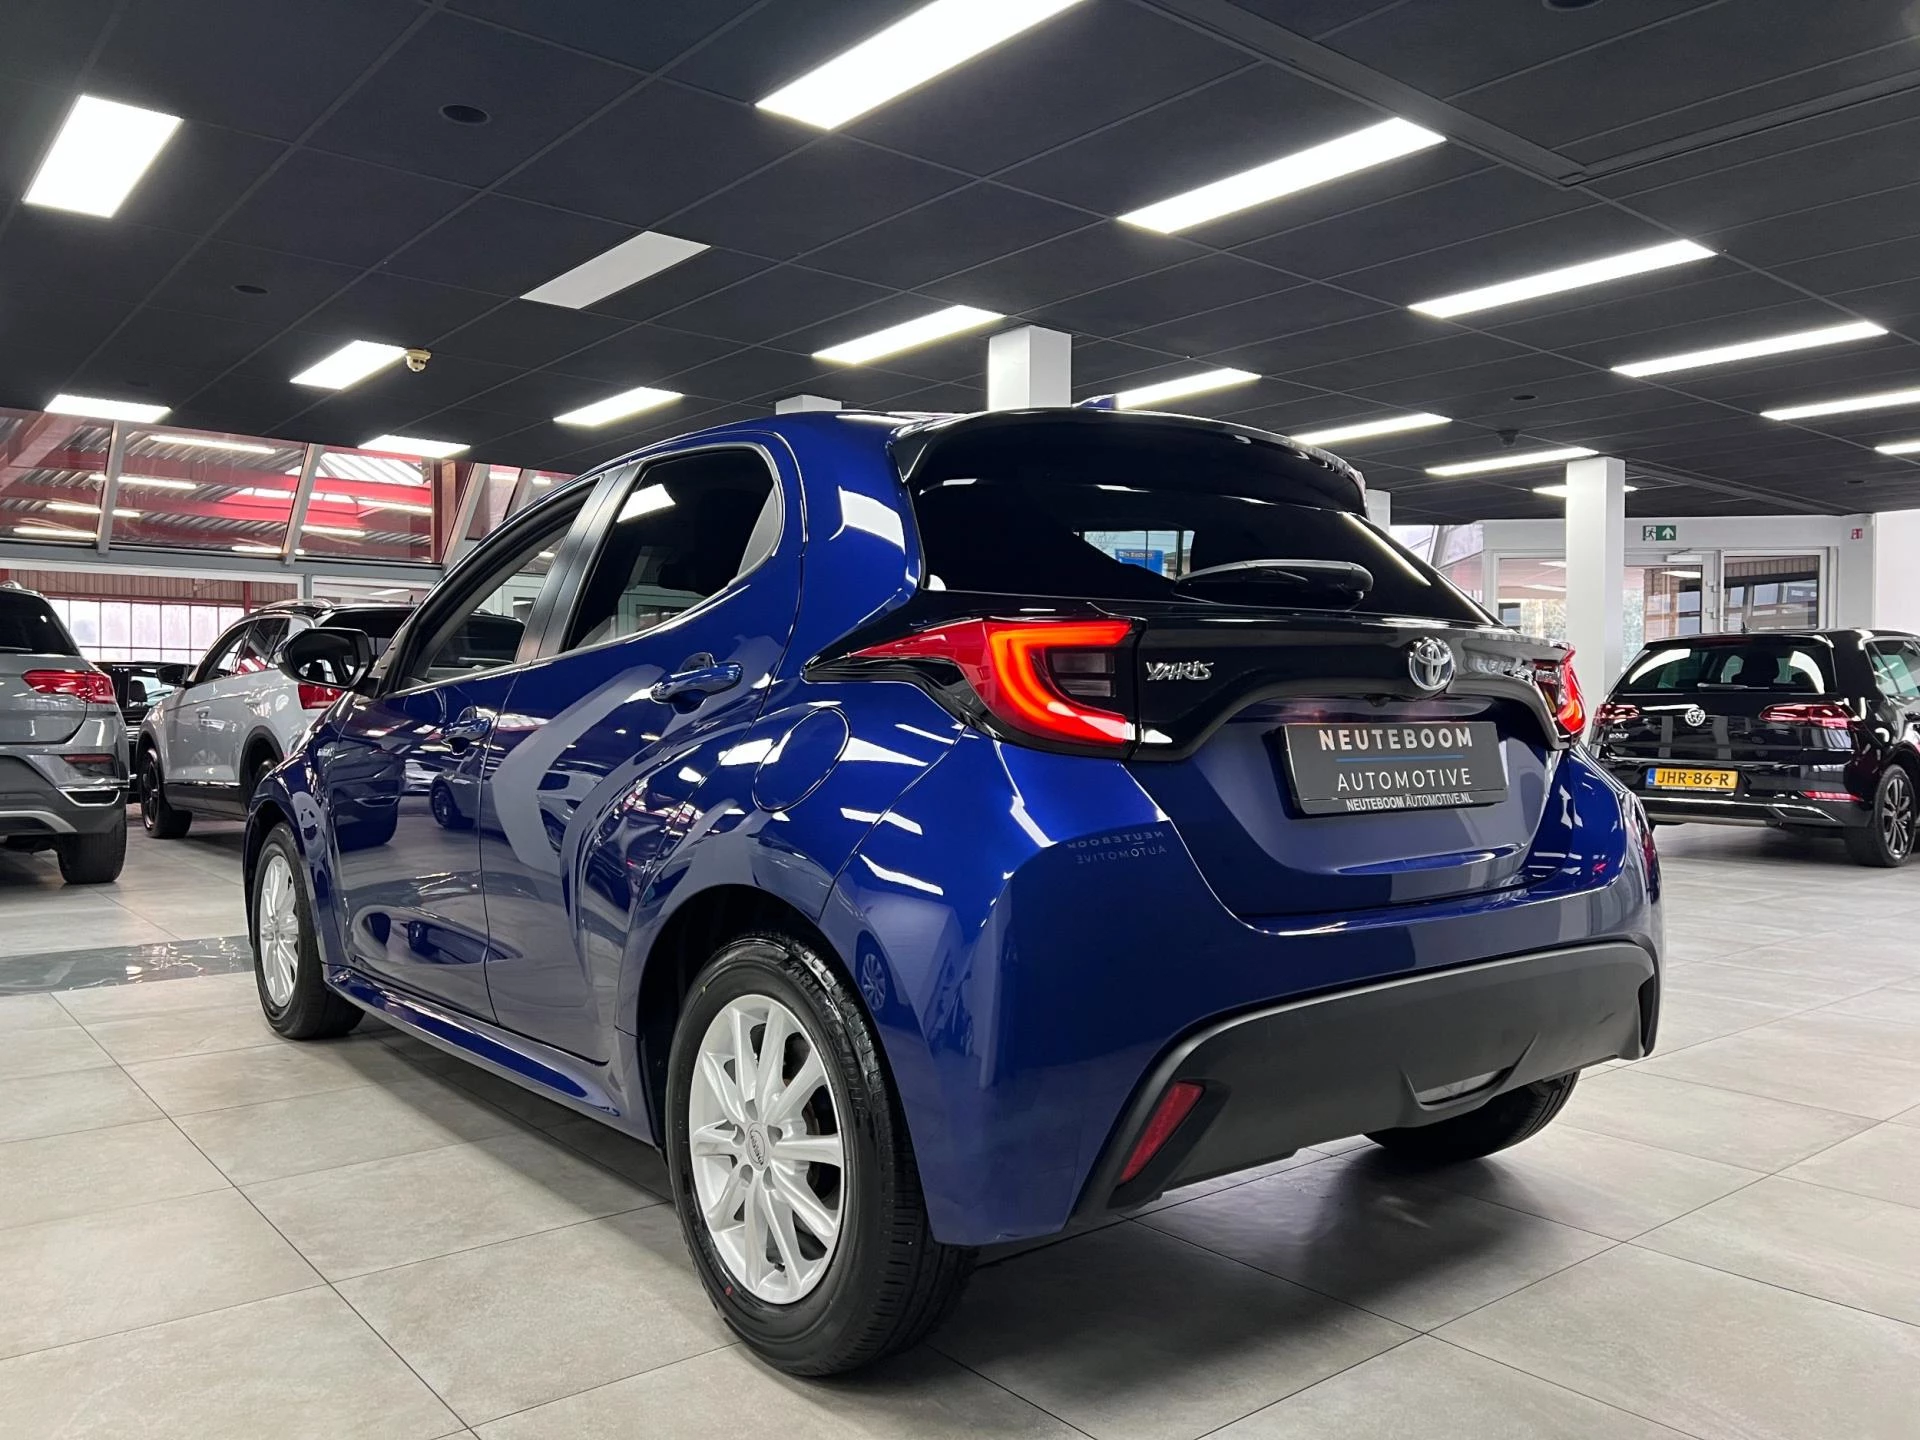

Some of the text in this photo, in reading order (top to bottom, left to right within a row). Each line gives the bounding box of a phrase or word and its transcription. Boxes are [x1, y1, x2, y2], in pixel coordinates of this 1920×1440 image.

[1146, 660, 1214, 680] YARIS
[1318, 727, 1473, 751] NEUTEBOOM
[1337, 768, 1472, 792] AUTOMOTIVE
[1657, 771, 1729, 786] JHR-86-R
[1346, 796, 1405, 811] NEUTEBOOM
